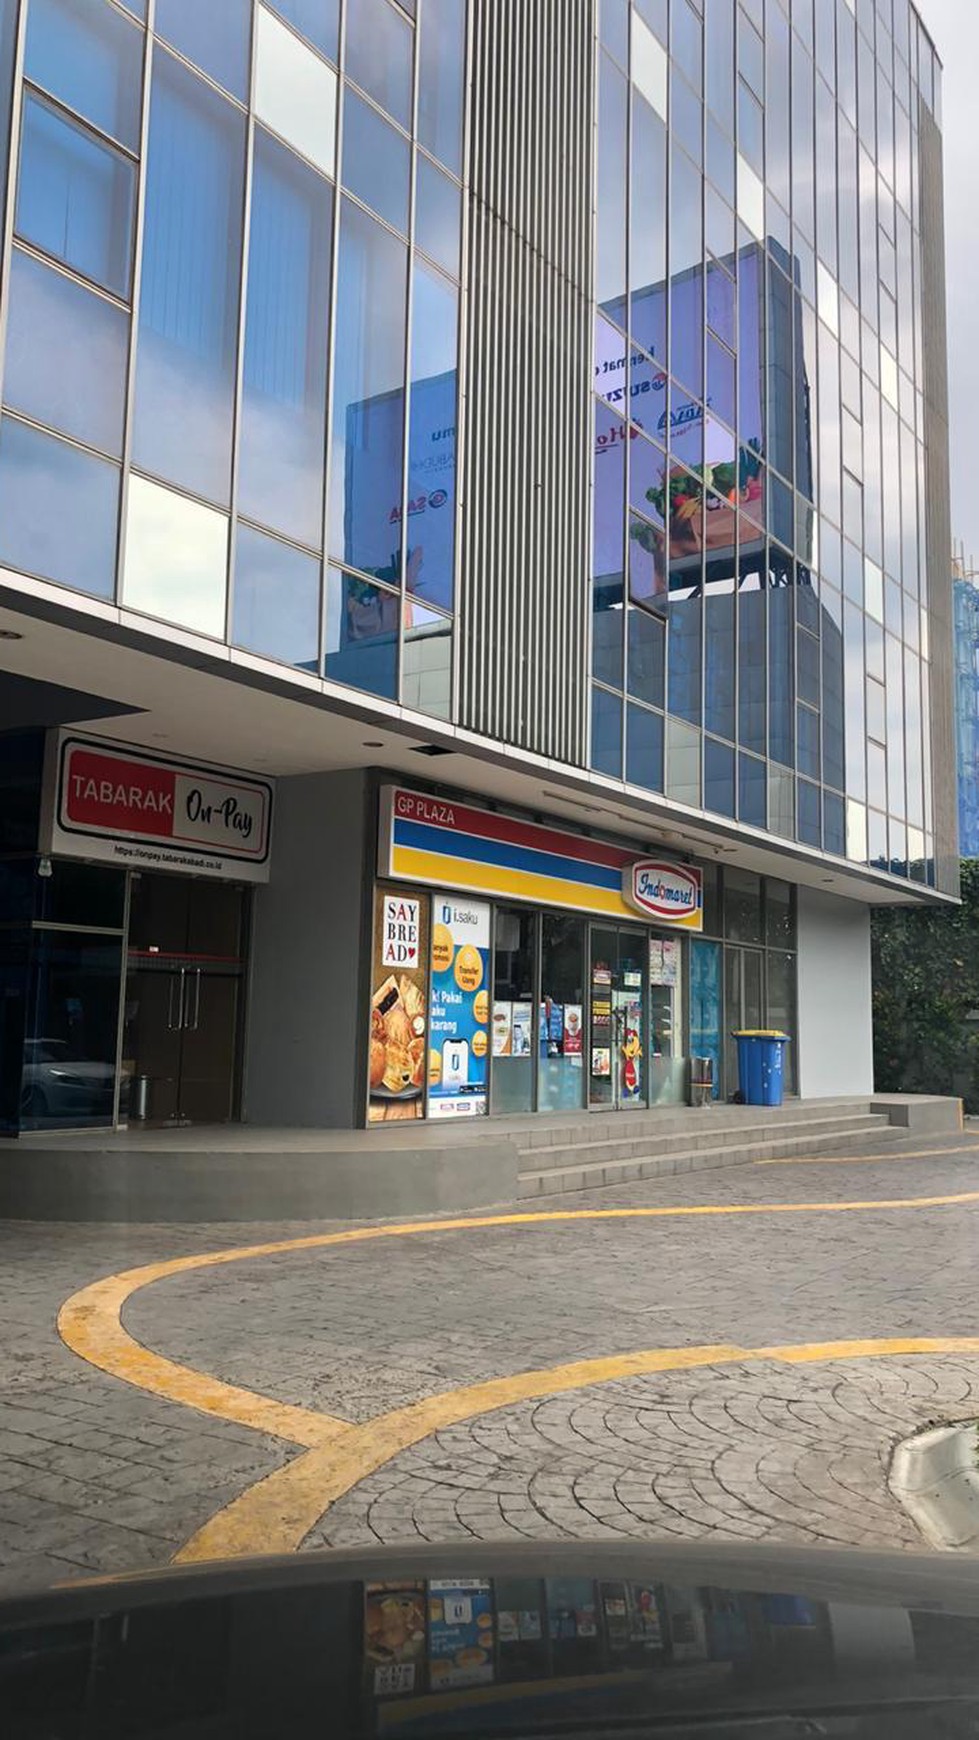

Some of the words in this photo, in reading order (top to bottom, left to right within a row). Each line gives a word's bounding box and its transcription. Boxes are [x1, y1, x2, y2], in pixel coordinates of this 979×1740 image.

[72, 775, 172, 814] TABARAK
[187, 789, 252, 838] On-Pay
[397, 796, 414, 813] GP
[416, 801, 455, 825] PLAZA
[638, 872, 693, 905] Indomaret
[387, 902, 417, 922] SAY
[453, 907, 478, 925] i.saku
[387, 922, 417, 942] BRE
[386, 943, 407, 962] AD
[441, 991, 462, 1005] Pakai
